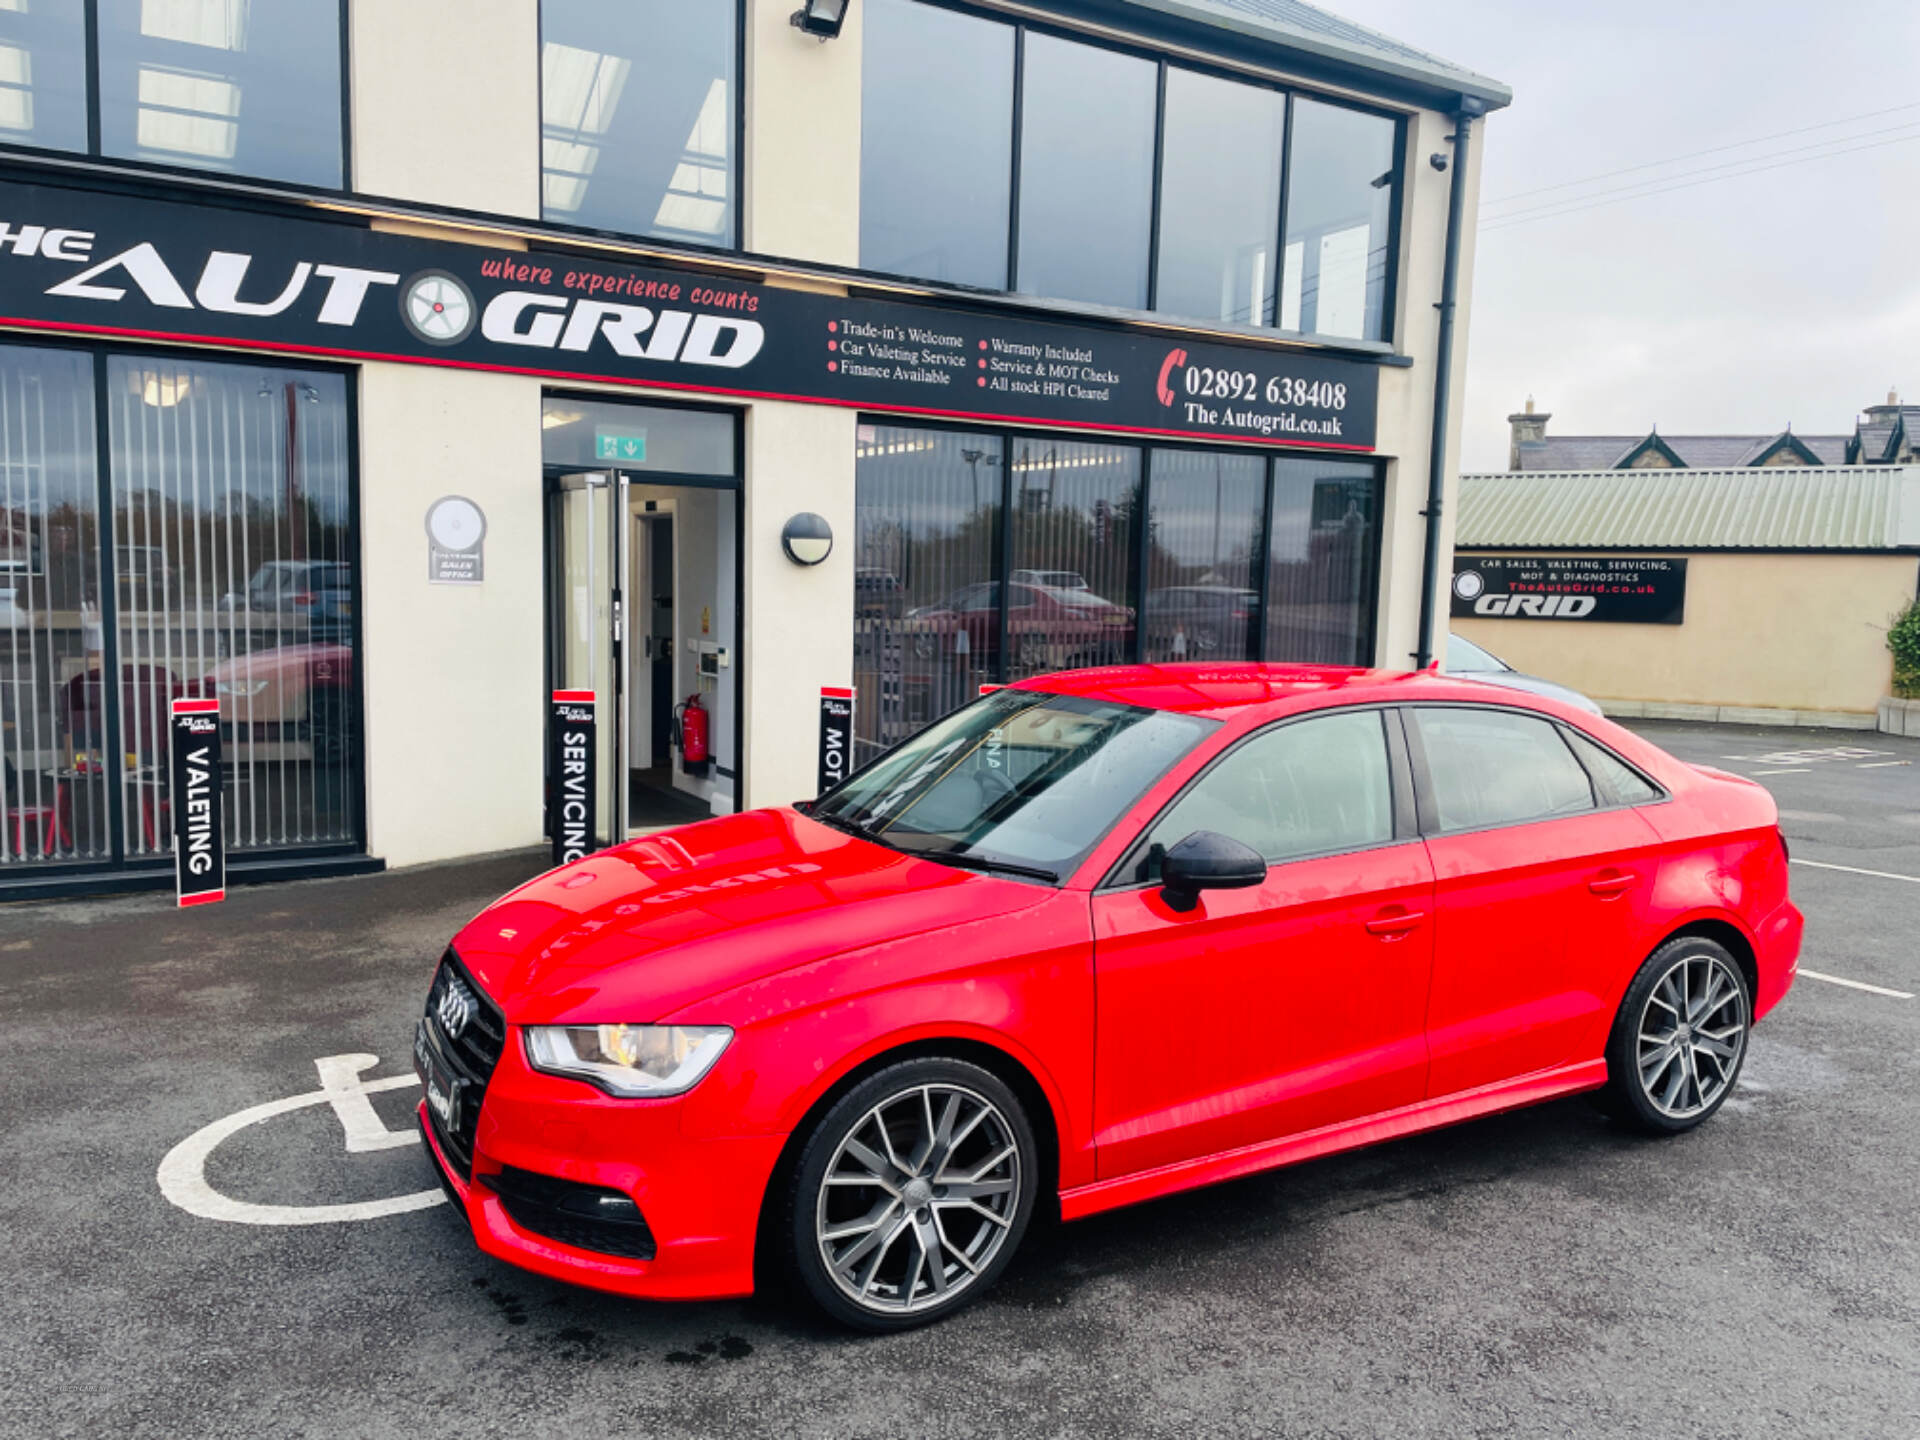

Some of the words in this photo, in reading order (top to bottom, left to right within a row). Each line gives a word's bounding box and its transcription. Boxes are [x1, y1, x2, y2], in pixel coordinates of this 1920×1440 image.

[481, 257, 553, 285] where
[563, 269, 681, 301] experience
[690, 281, 760, 312] counts
[481, 290, 765, 369] GRID
[840, 319, 905, 341] Trade-in's
[908, 328, 963, 348] Welcome
[840, 340, 864, 356] Car
[868, 342, 919, 365] Valeting
[921, 349, 967, 367] Service
[991, 338, 1043, 360] Warranty
[1045, 344, 1093, 363] Included
[840, 360, 890, 379] Finance
[893, 365, 951, 384] Available
[990, 357, 1032, 374] Service
[1035, 362, 1046, 377] &
[1049, 364, 1079, 380] MOT
[1081, 367, 1120, 384] Checks
[990, 376, 1008, 391] All
[1011, 380, 1040, 394] stock
[1043, 381, 1065, 397] HPI
[1068, 384, 1110, 401] Cleared
[1185, 366, 1257, 401] 02892
[1265, 377, 1347, 410] 638408
[1184, 402, 1218, 425] The
[1221, 407, 1342, 435] Autogrid.co.uk
[1481, 560, 1501, 569] CAR
[1521, 572, 1544, 580] MOT
[1549, 572, 1558, 581] &
[1563, 572, 1639, 582] DIAGNOSTICS
[1474, 594, 1597, 617] GRID
[825, 728, 842, 781] MOT
[186, 747, 212, 875] VALETING
